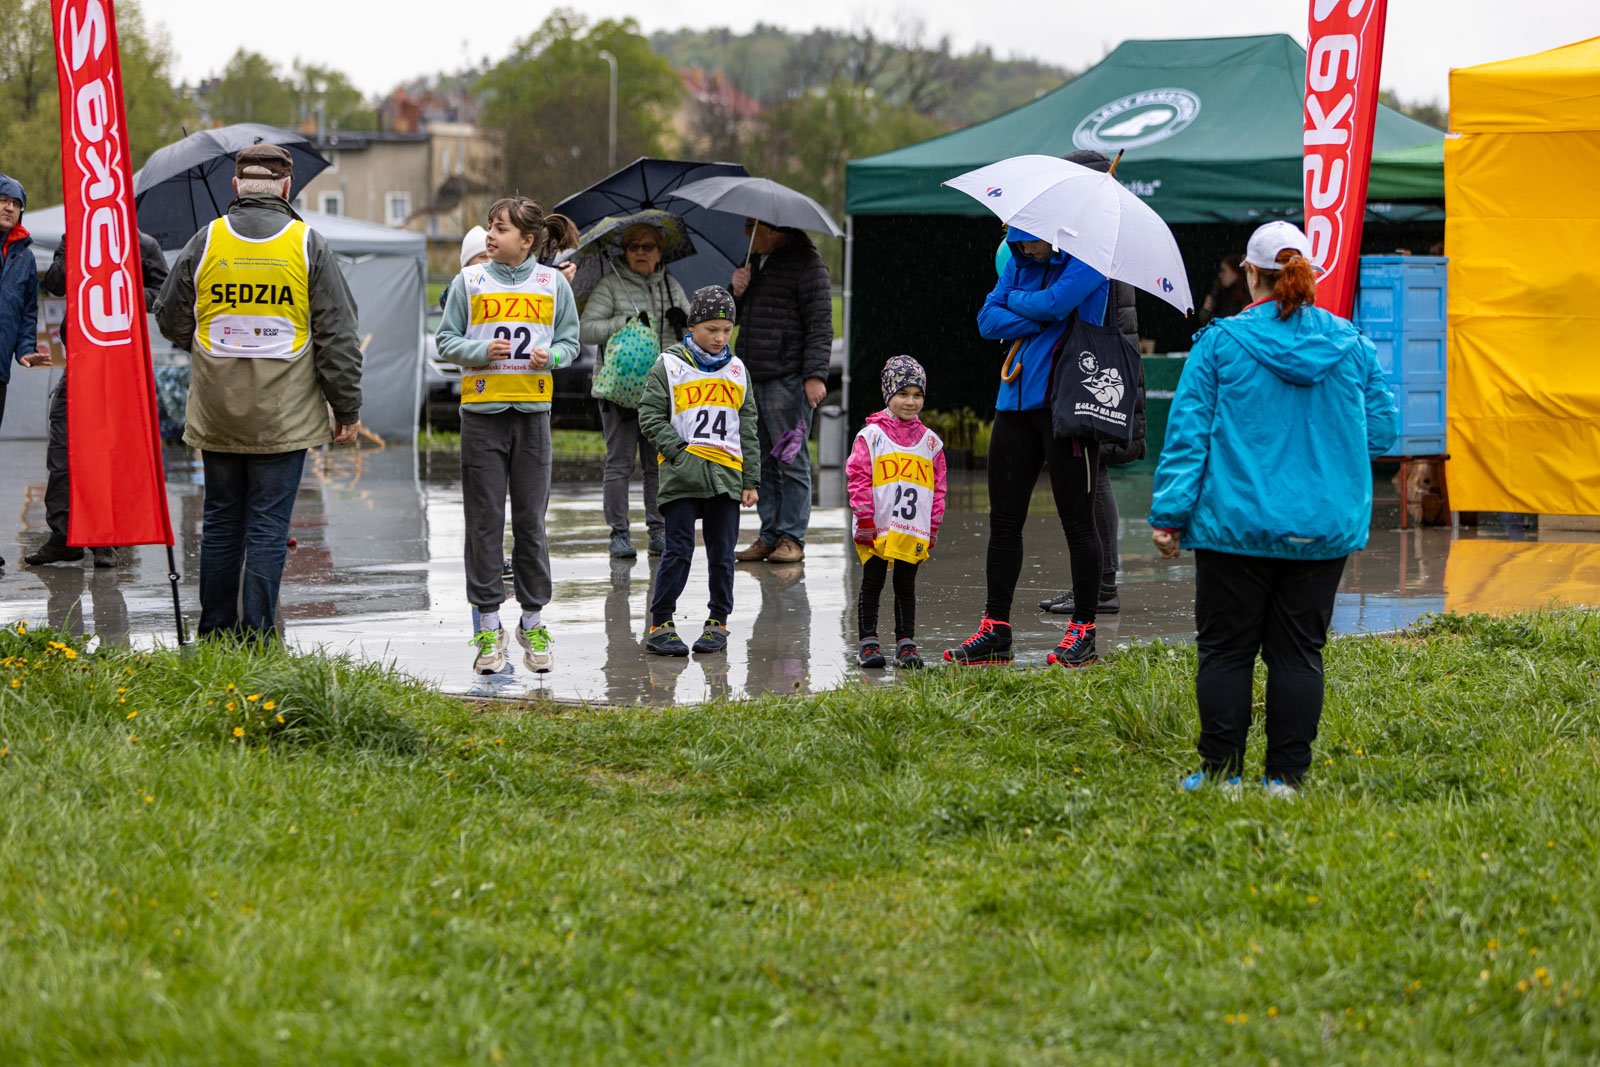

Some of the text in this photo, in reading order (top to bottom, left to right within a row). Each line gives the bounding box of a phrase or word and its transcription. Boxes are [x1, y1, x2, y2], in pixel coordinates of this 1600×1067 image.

[211, 283, 294, 308] SĘDZIA
[482, 298, 542, 319] DZN
[685, 383, 735, 405] DZN
[1100, 407, 1110, 417] NA
[693, 409, 727, 441] 24
[880, 457, 929, 484] DZN
